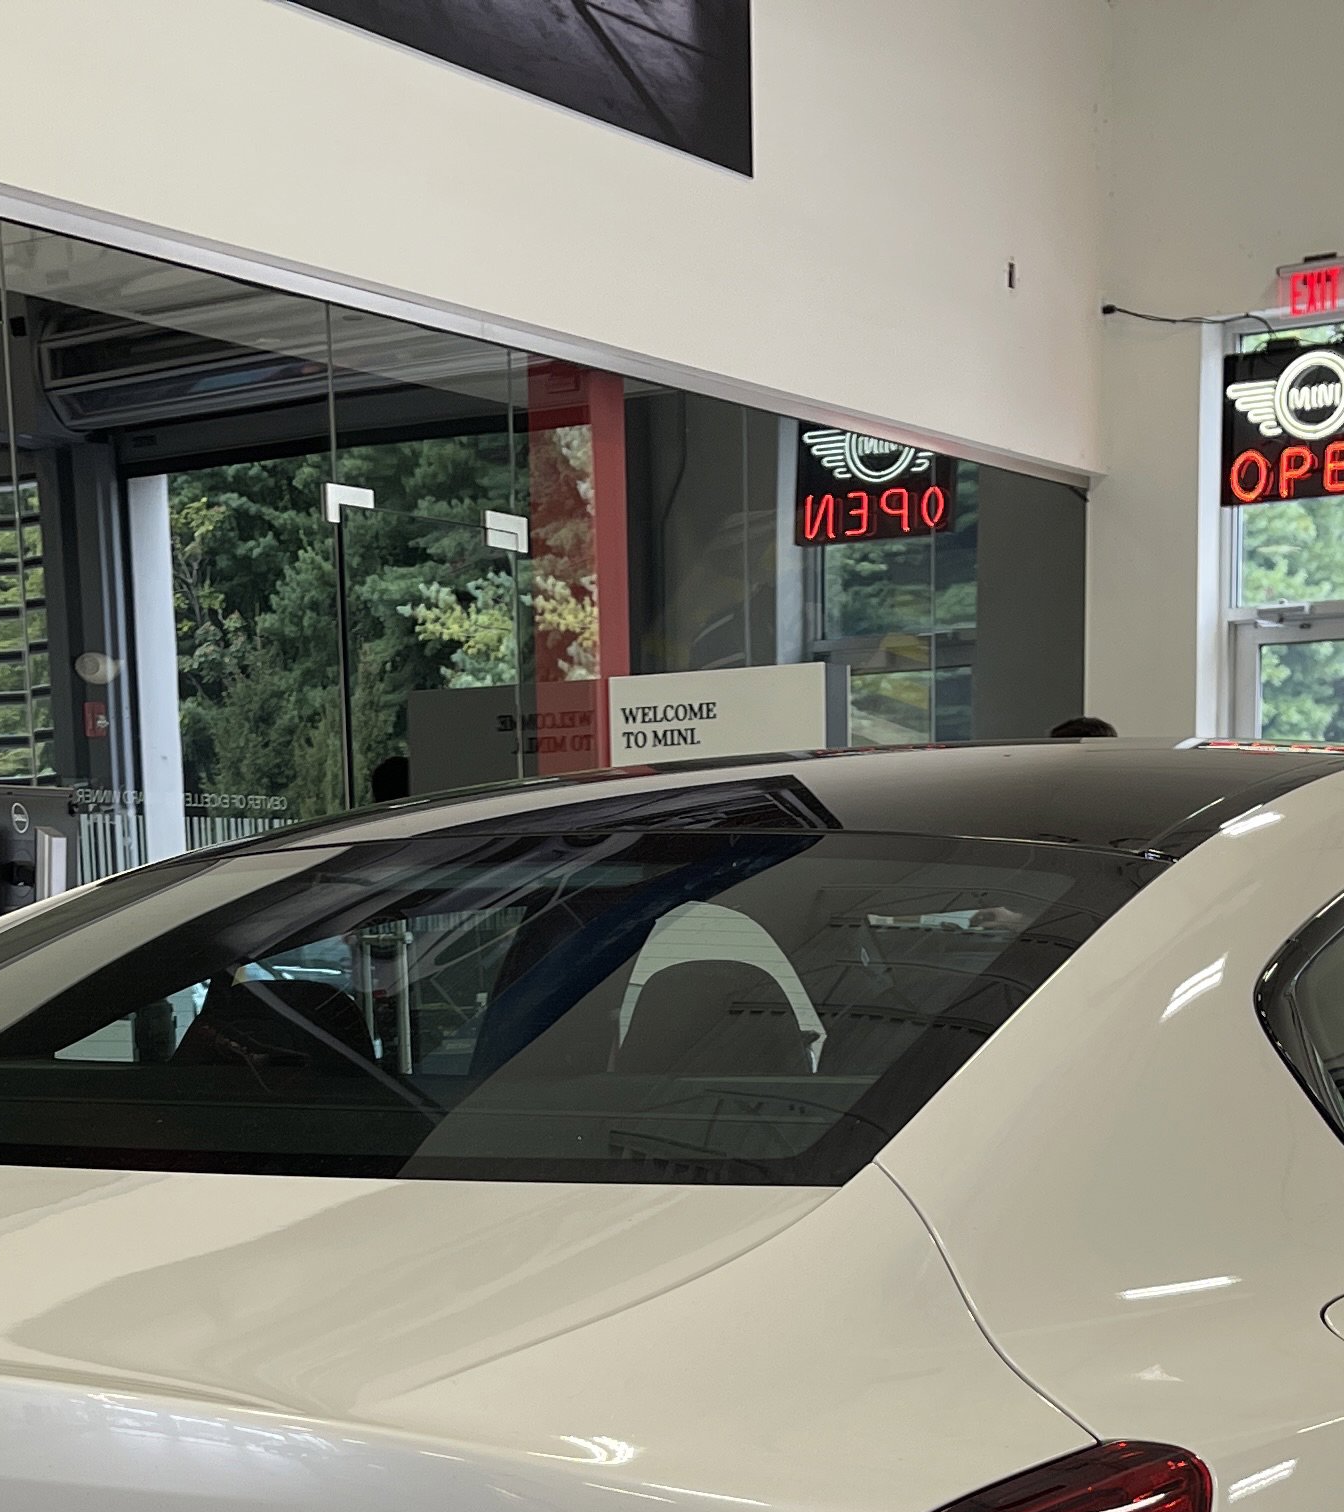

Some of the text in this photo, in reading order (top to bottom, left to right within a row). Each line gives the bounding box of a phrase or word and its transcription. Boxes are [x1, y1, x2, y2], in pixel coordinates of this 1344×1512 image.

[1289, 266, 1342, 316] EXIT
[1289, 382, 1342, 411] MINI
[621, 702, 717, 724] WELCOME
[622, 728, 701, 749] TO MINI.
